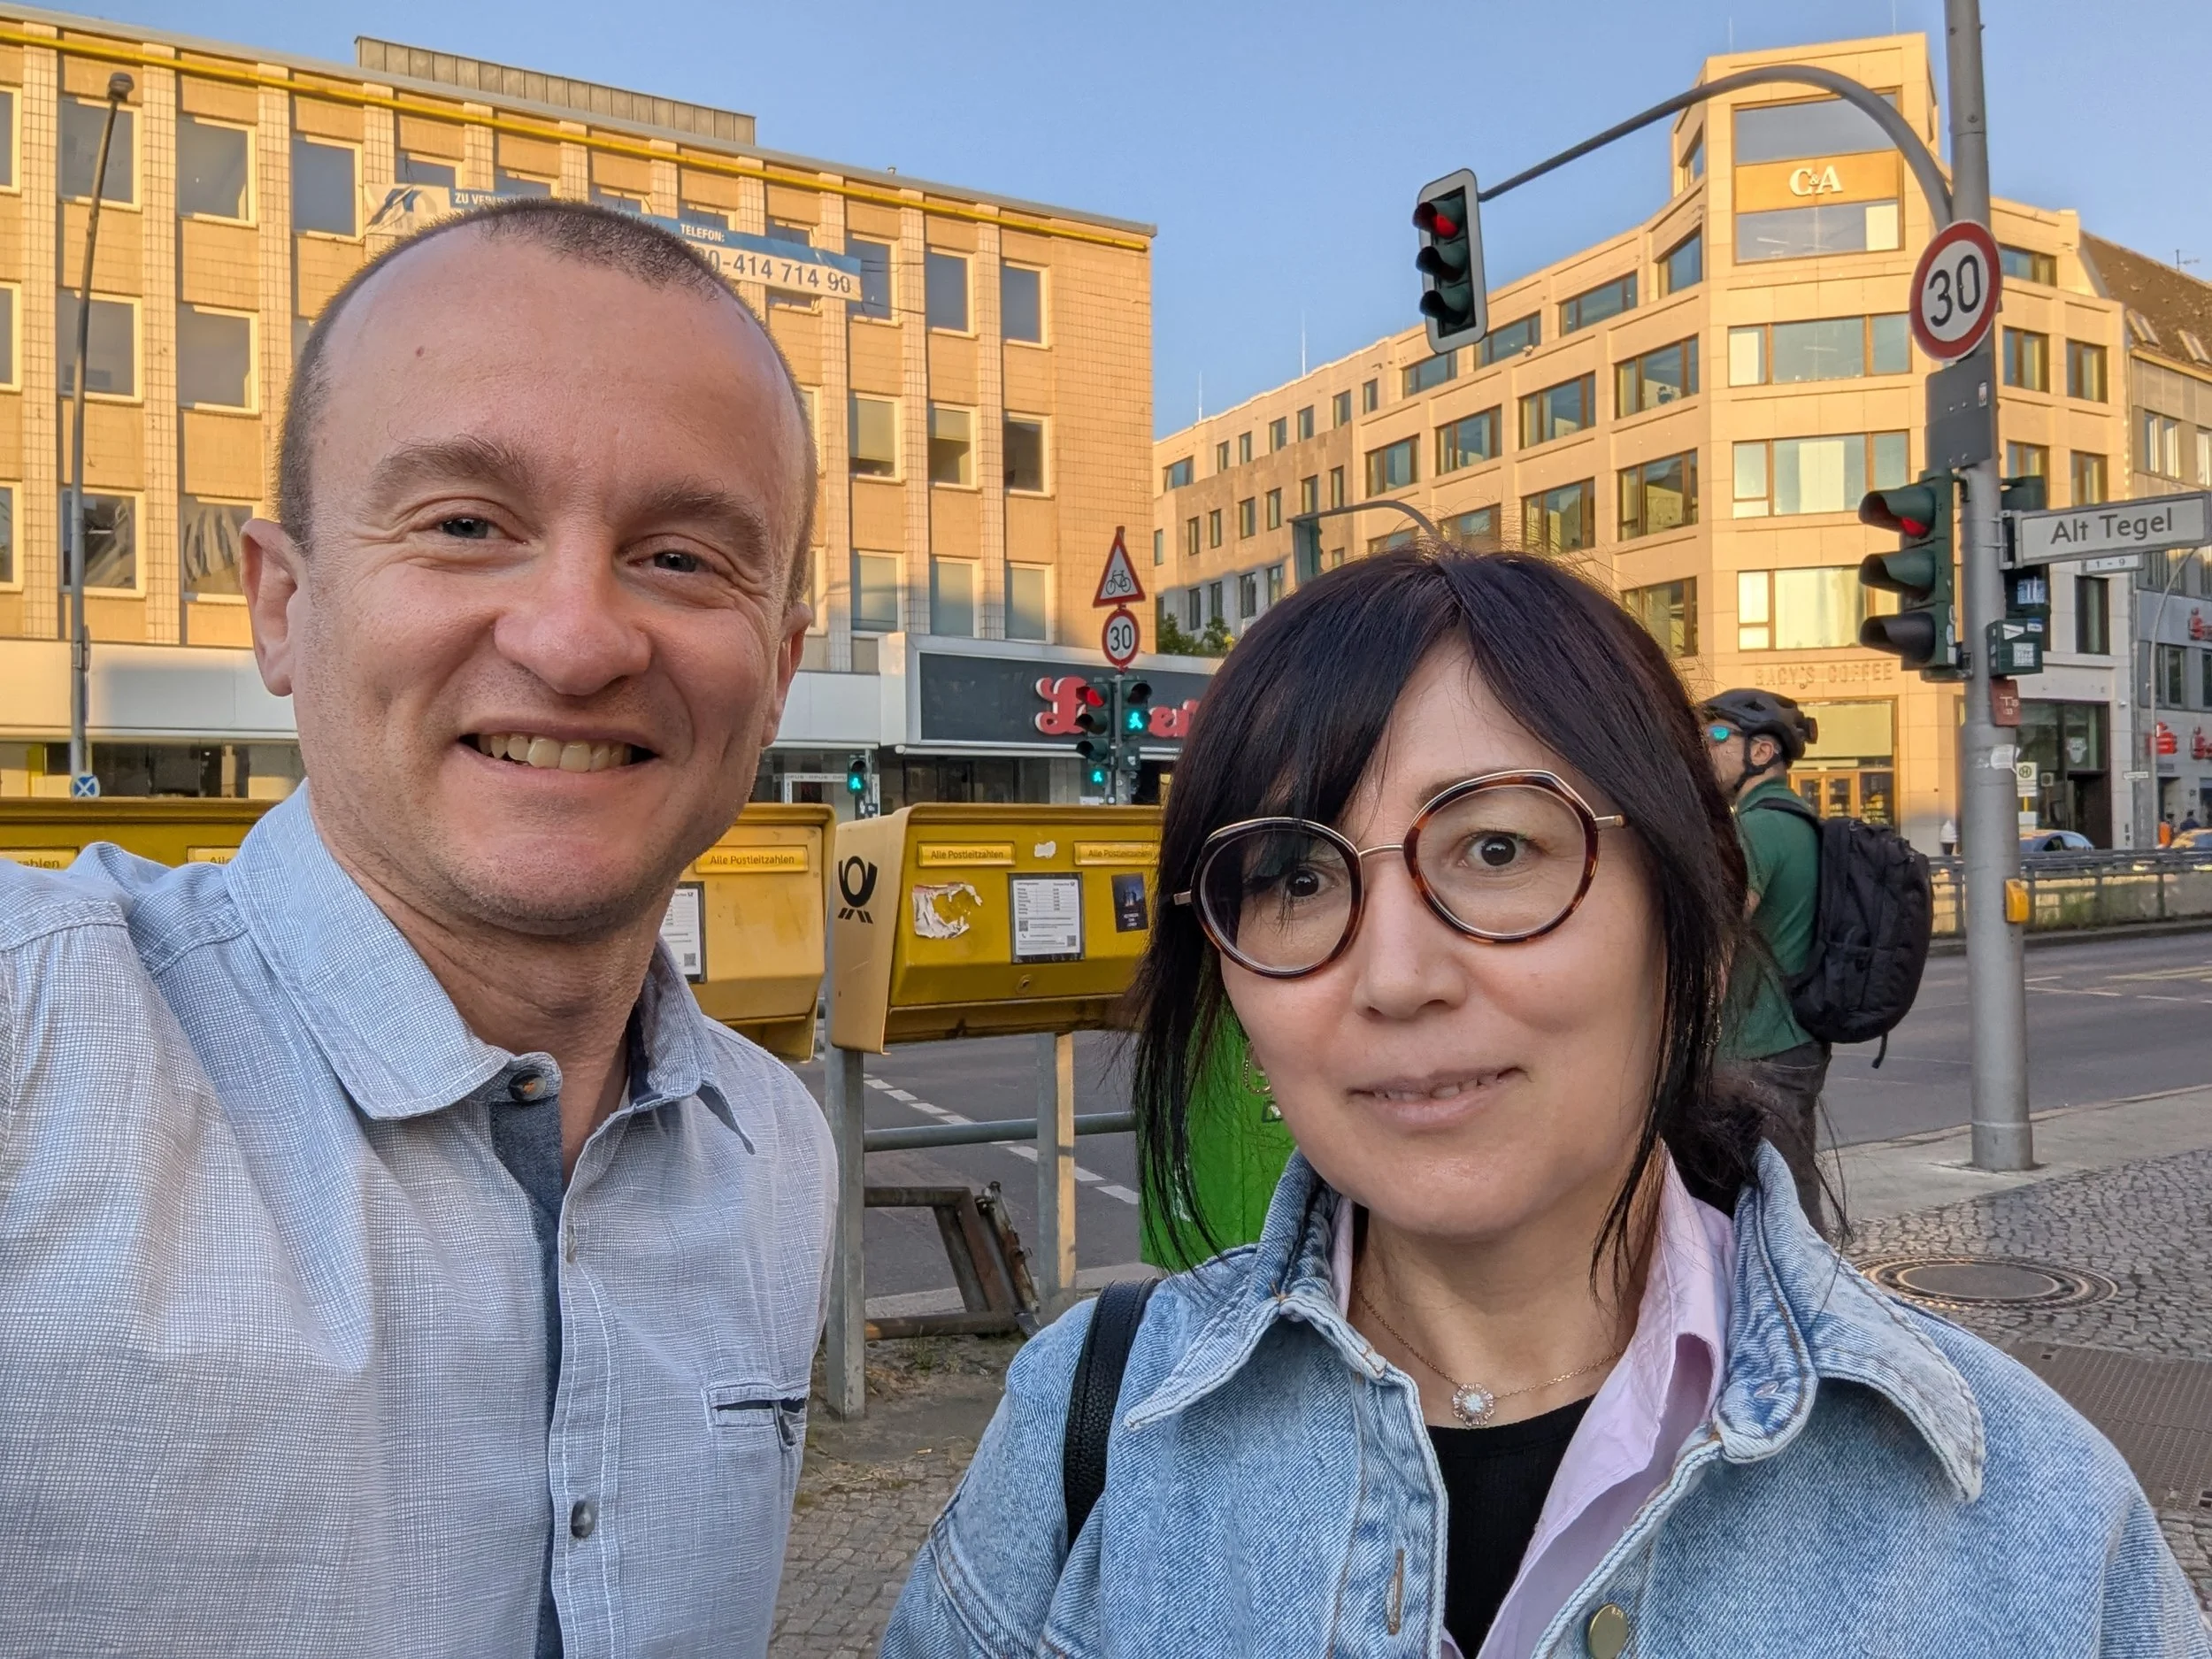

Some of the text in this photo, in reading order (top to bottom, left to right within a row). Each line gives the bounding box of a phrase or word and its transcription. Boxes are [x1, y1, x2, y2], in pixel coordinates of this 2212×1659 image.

[1789, 165, 1843, 196] C&A
[455, 193, 469, 204] ZU
[680, 224, 726, 243] TELEFON:
[780, 263, 819, 288] 714
[827, 272, 851, 294] 90
[1929, 255, 1980, 326] 30
[2050, 507, 2172, 544] Alt Tegel
[1110, 624, 1132, 651] 30
[710, 855, 795, 865] Alle Postleitzahlen
[932, 849, 1003, 859] Alle Postleitzahlen
